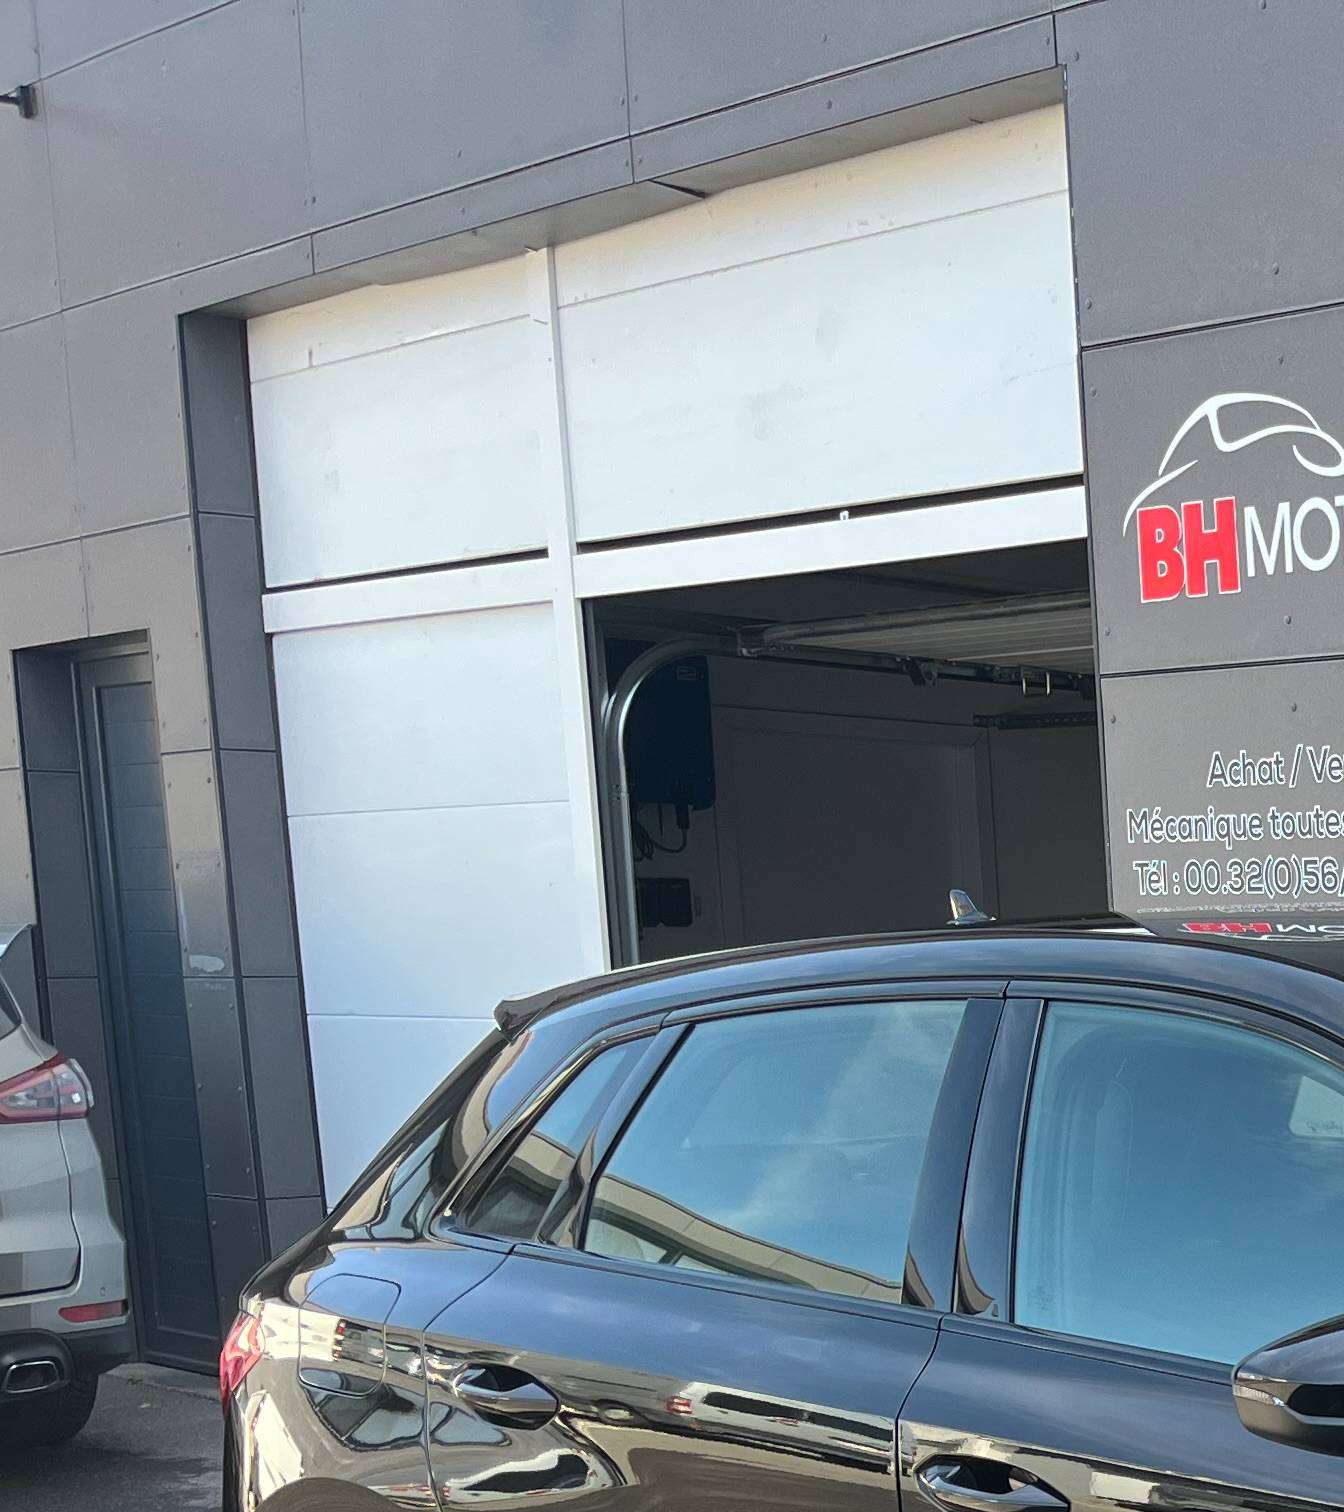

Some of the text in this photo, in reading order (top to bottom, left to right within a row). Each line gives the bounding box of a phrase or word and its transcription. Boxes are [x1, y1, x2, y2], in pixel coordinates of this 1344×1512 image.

[1136, 496, 1241, 603] BH
[1206, 751, 1285, 787] Achat
[1126, 806, 1263, 849] Mécanique
